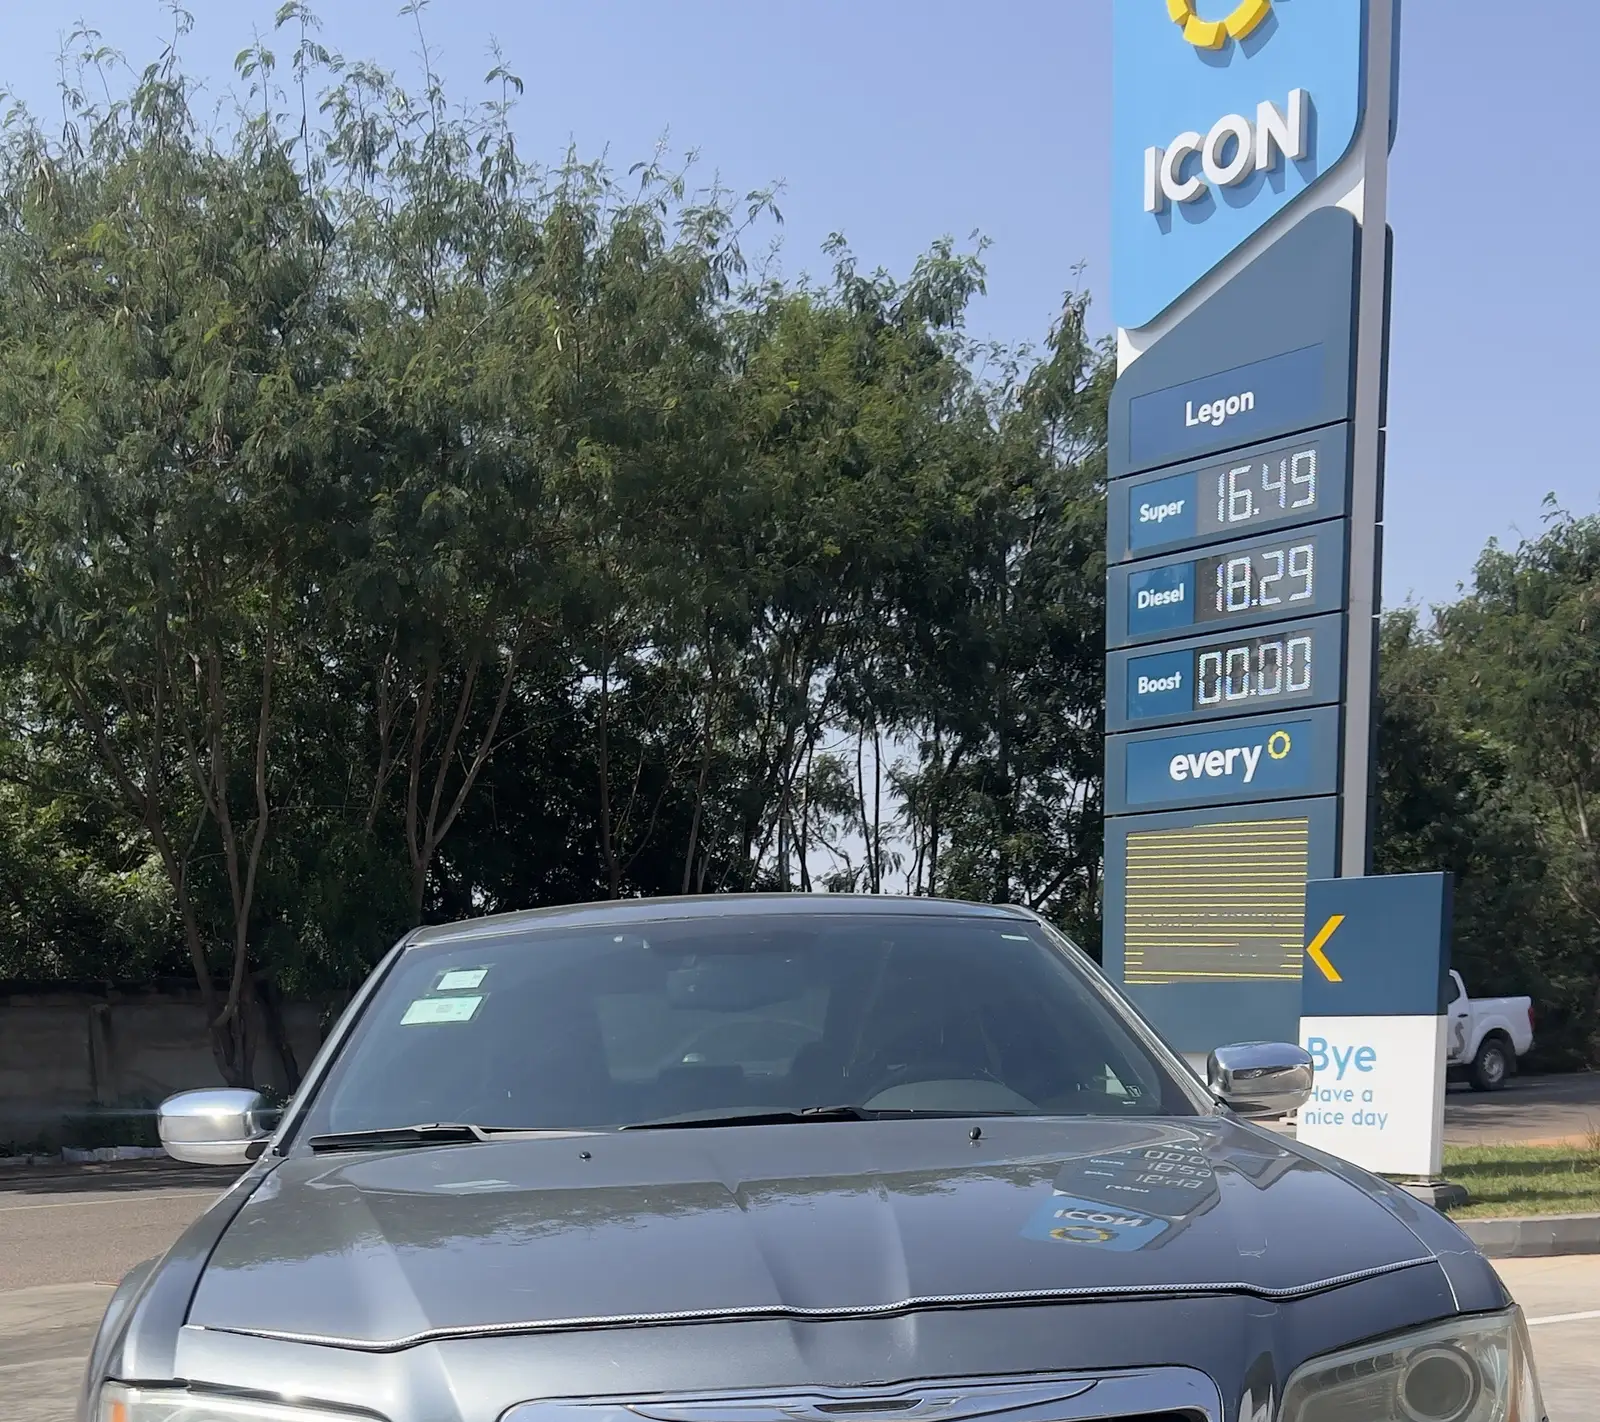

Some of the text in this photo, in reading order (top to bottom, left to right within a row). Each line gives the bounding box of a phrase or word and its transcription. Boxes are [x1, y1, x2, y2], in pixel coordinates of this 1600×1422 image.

[1144, 88, 1309, 213] ICON
[1185, 391, 1255, 427] Legon
[1139, 449, 1317, 524] Super 16.49
[1137, 543, 1314, 612] Diesel 18.29
[1137, 636, 1311, 705] Boost 00.00
[1307, 1037, 1377, 1080] Bye
[1305, 1108, 1388, 1130] nice day
[1362, 1089, 1373, 1102] a
